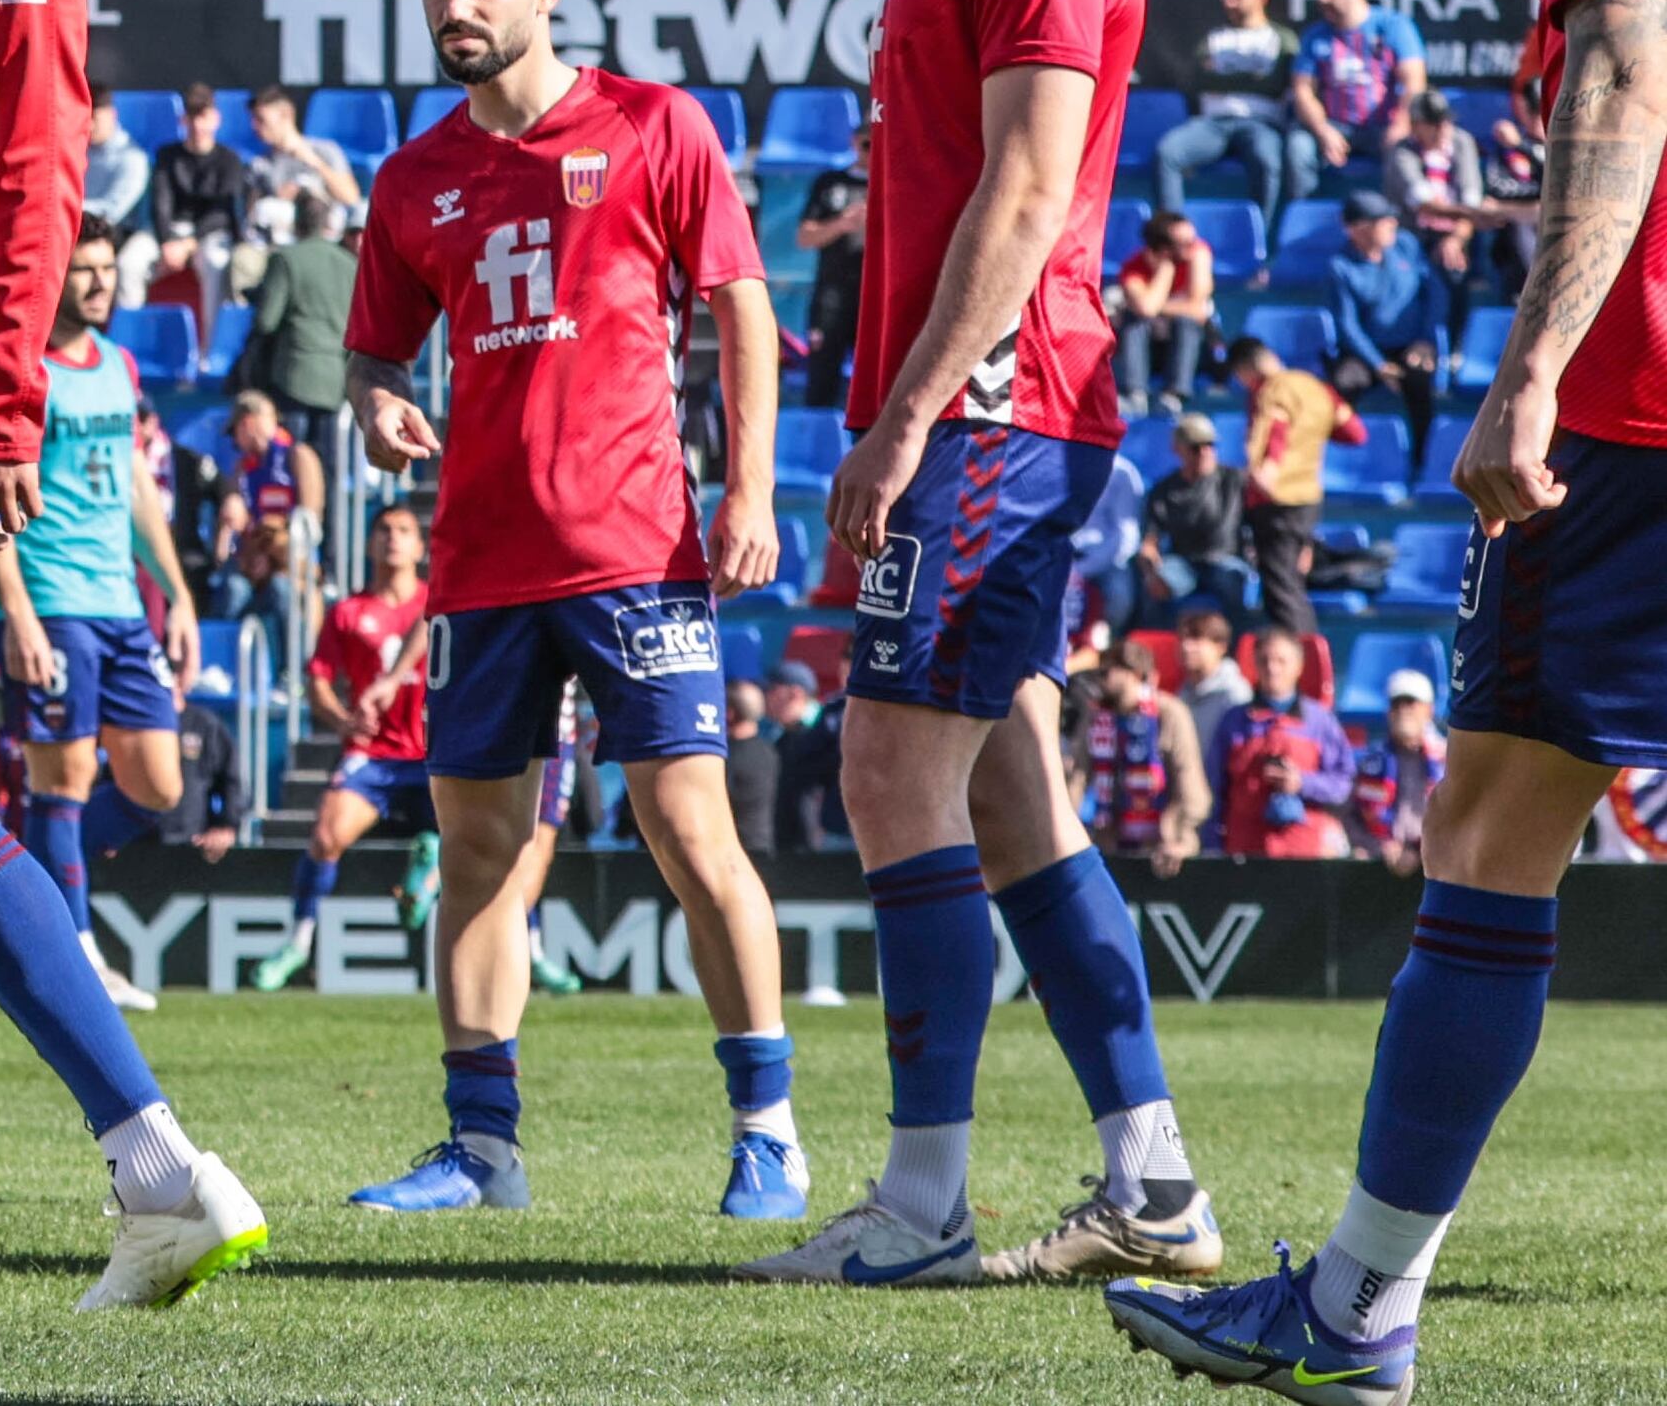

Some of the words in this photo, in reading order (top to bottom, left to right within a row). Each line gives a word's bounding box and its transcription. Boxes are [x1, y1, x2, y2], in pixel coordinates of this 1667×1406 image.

[474, 217, 557, 326] fi
[473, 314, 580, 356] network
[860, 558, 901, 597] RC
[632, 620, 710, 660] CRC
